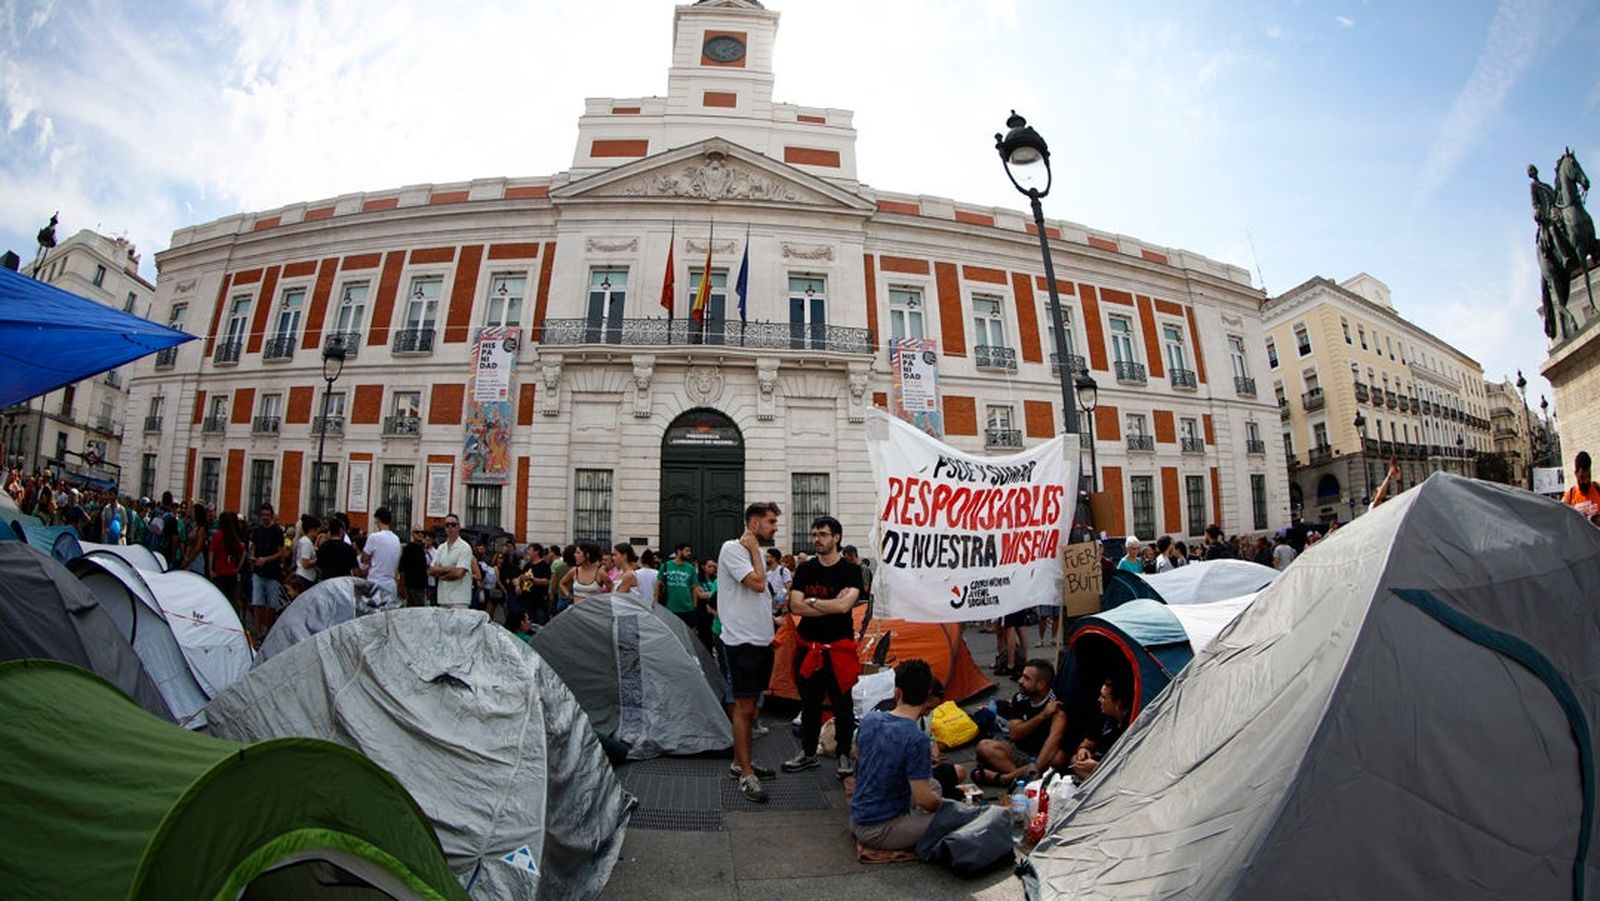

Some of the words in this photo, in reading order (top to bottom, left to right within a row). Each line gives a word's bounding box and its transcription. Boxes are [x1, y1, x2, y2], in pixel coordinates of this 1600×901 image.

[933, 456, 976, 482] PSOE
[975, 464, 987, 482] Y
[881, 477, 1064, 531] RESPONSABLES
[882, 530, 910, 568] DE
[911, 533, 998, 569] NUESTRA
